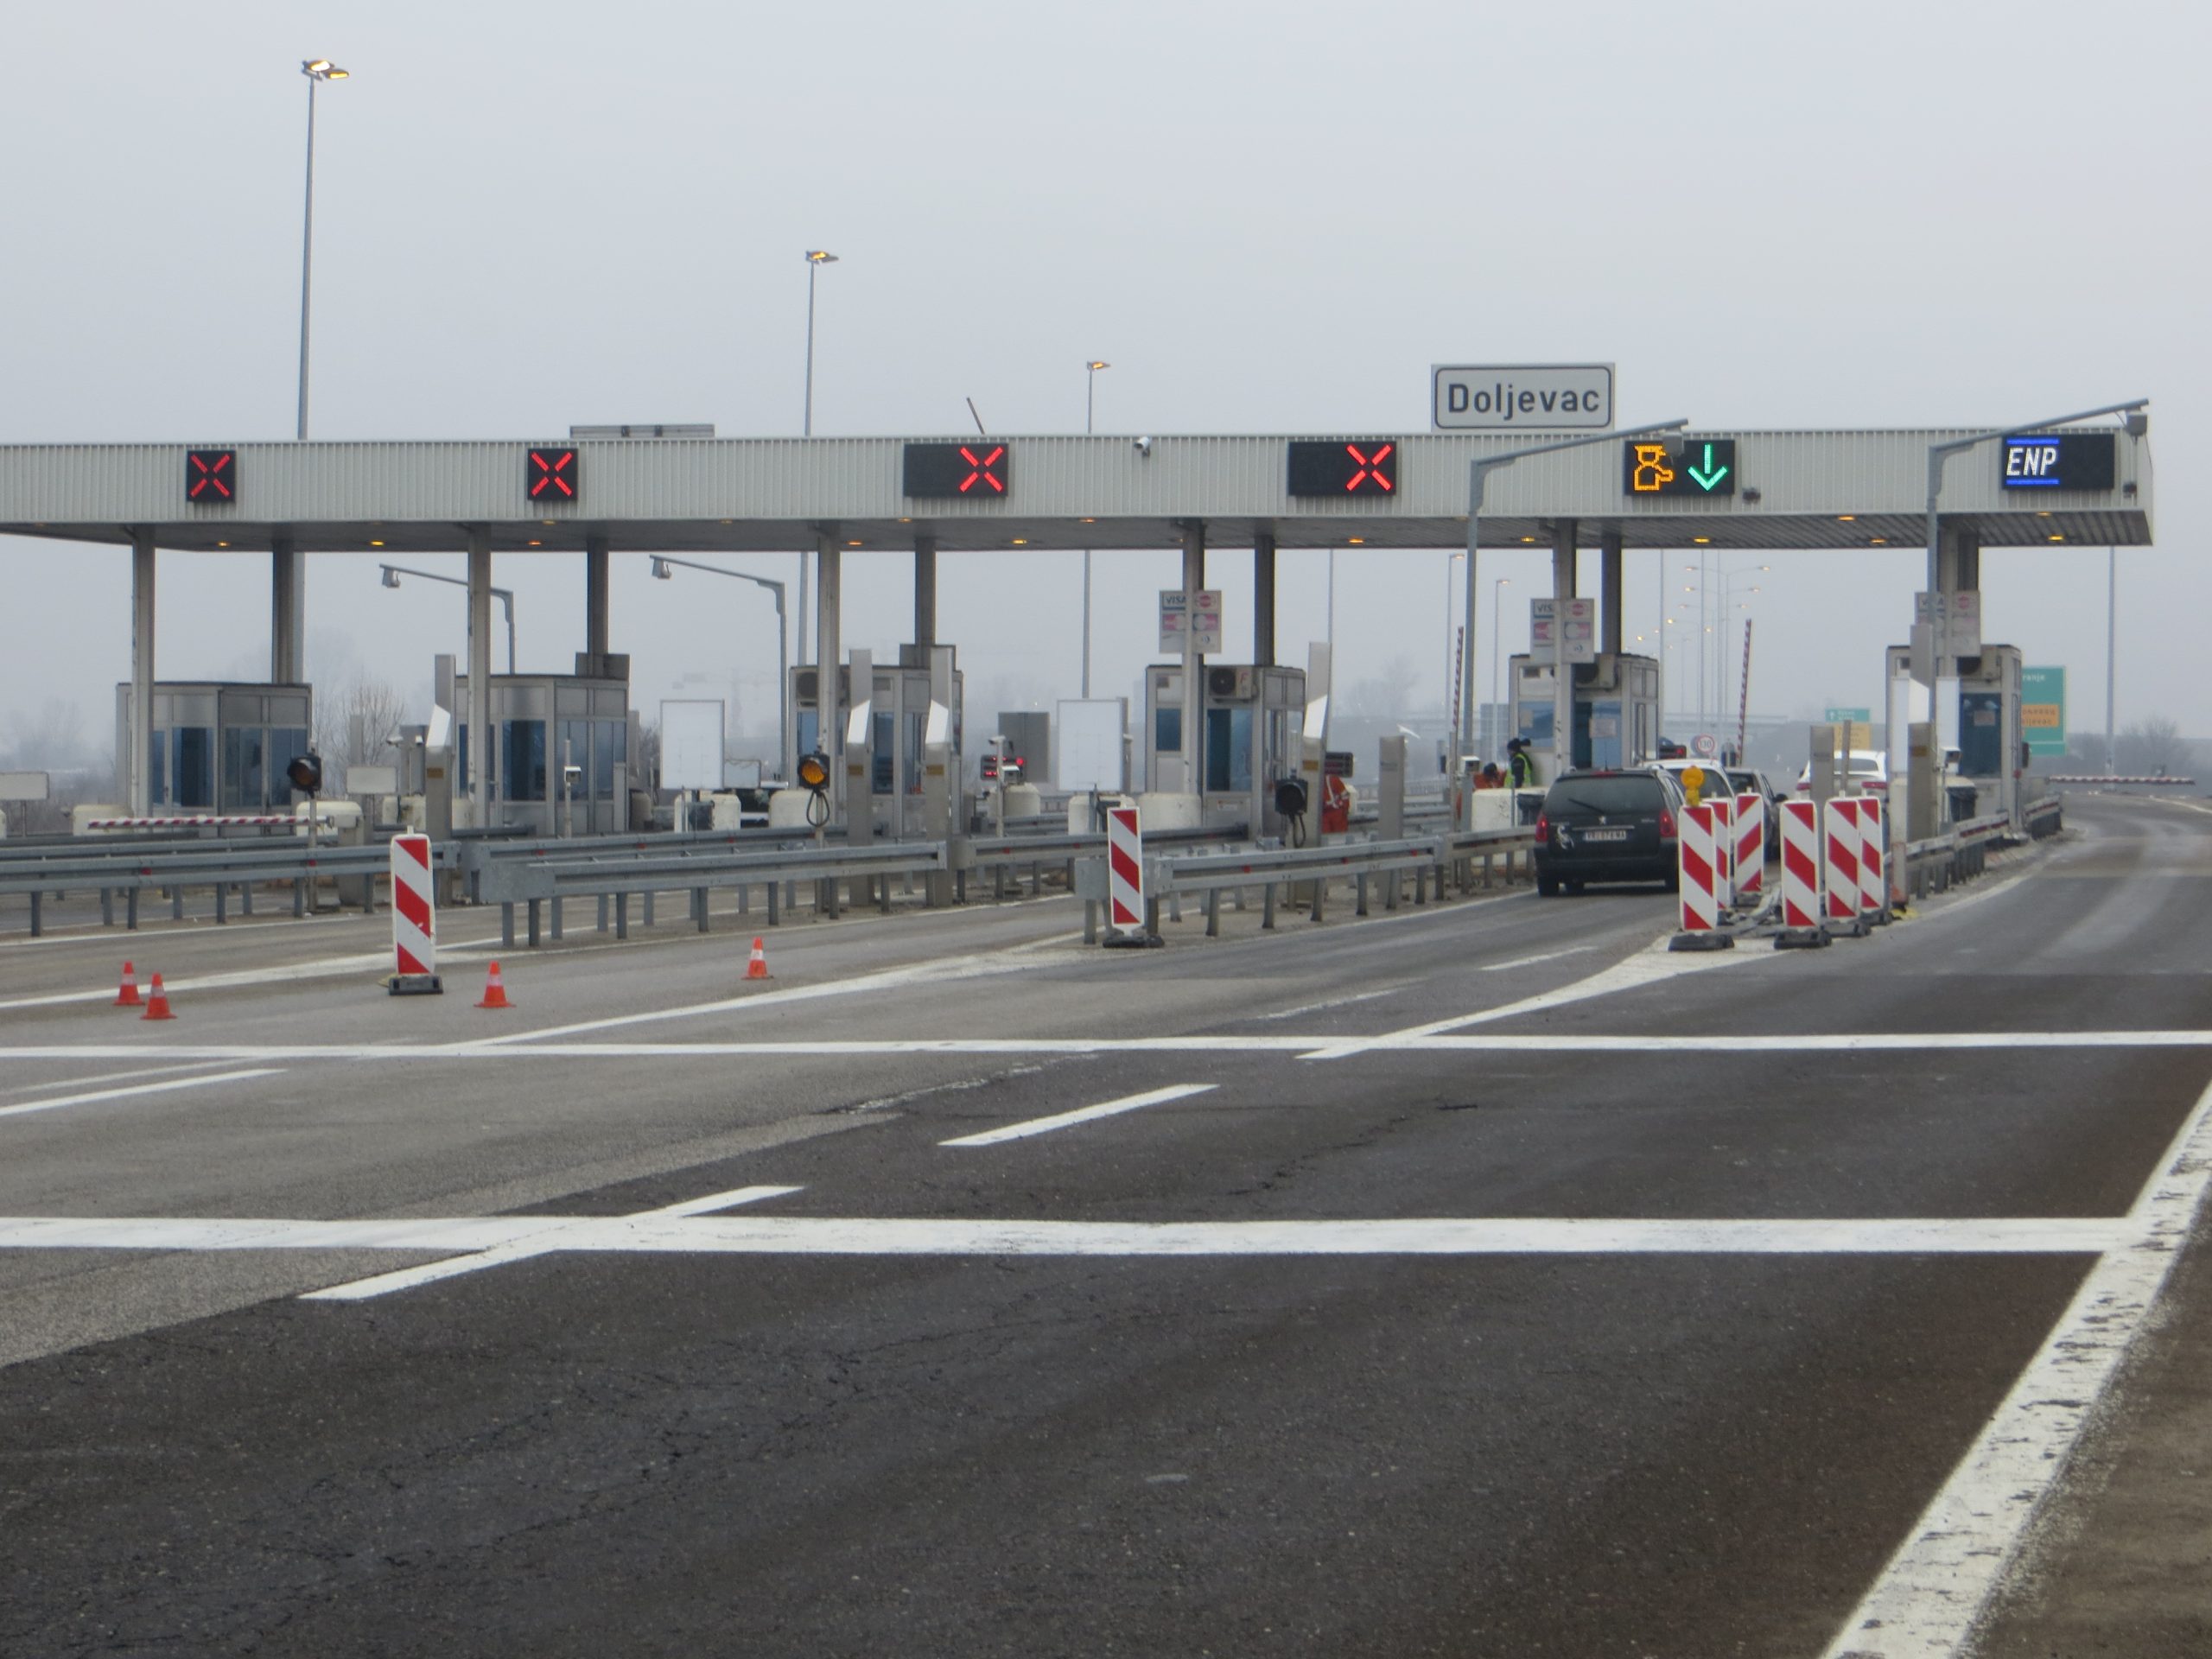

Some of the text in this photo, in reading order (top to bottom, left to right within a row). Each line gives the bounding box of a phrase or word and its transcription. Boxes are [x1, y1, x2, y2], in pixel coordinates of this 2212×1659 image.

[1448, 383, 1599, 421] Doljevac
[2006, 447, 2056, 476] ENP
[2022, 673, 2045, 683] ranje
